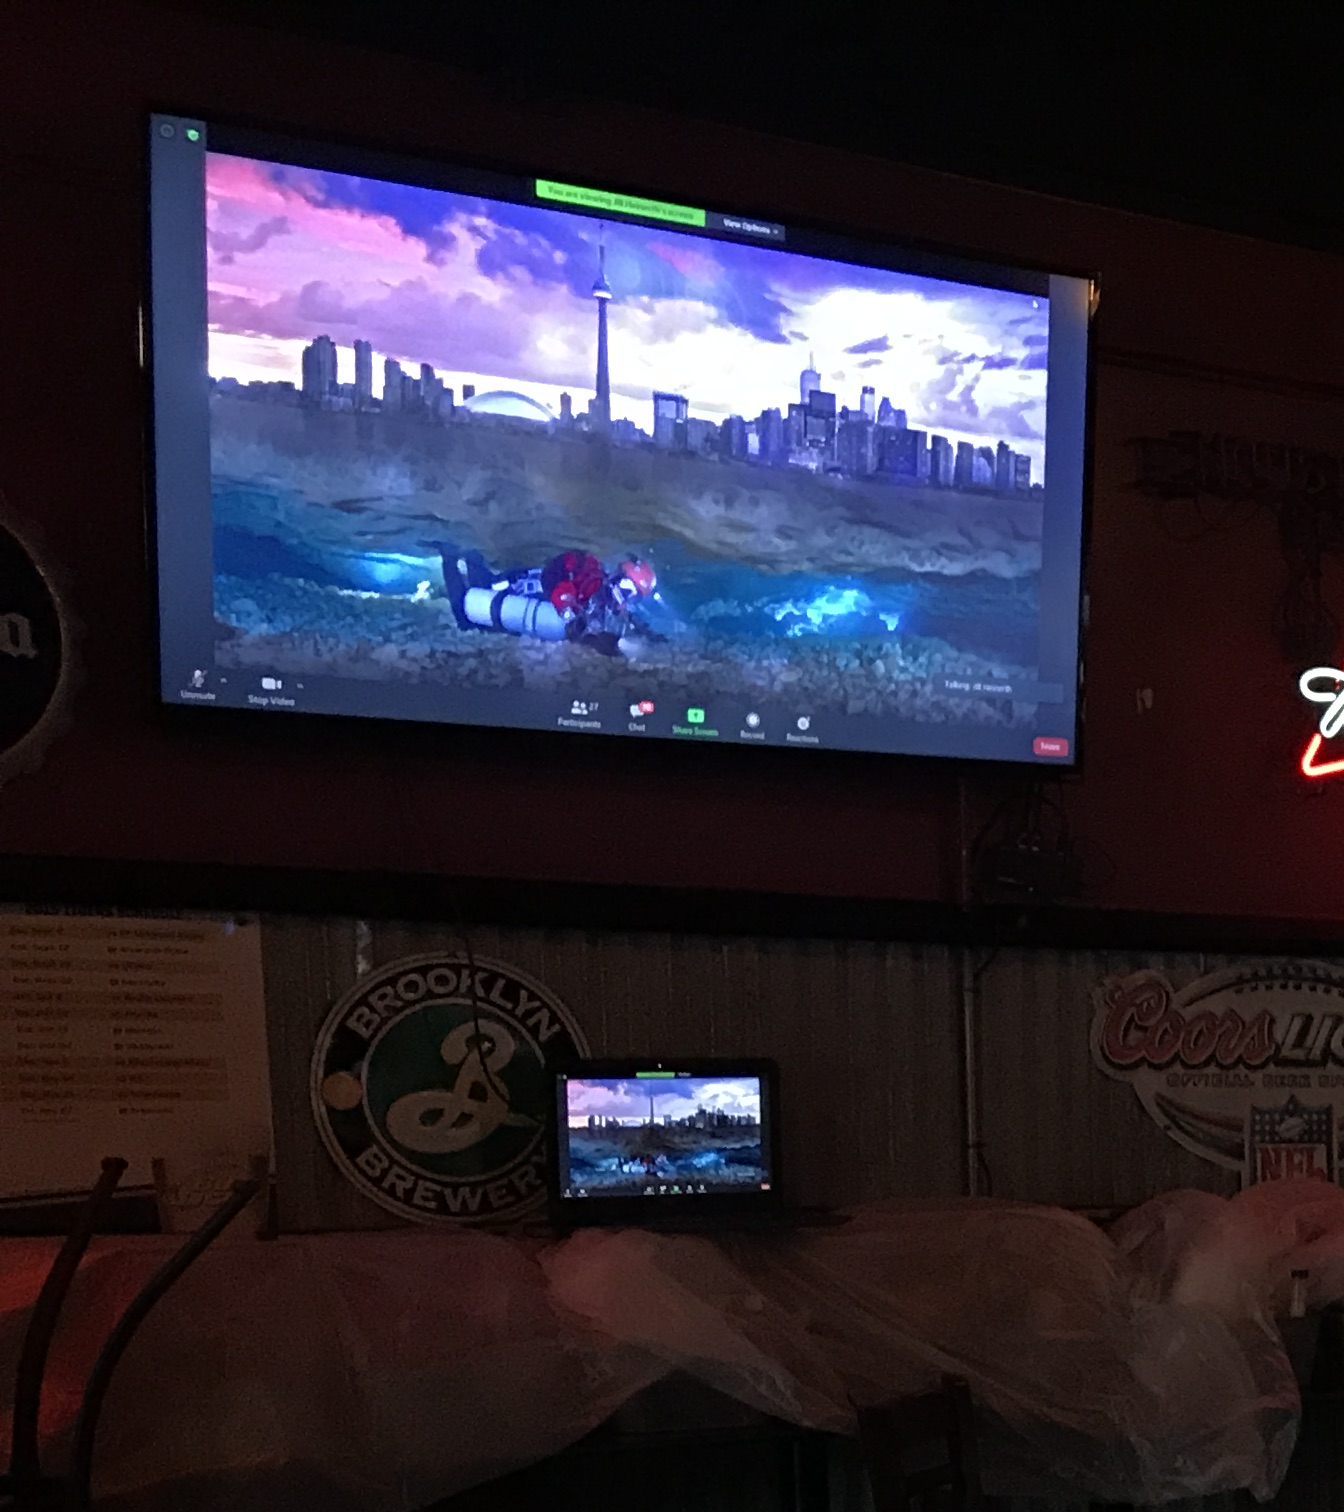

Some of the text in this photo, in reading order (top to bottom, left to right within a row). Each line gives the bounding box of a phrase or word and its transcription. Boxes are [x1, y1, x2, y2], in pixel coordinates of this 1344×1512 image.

[557, 716, 601, 729] Participants
[347, 966, 563, 1044] BROOKLYN
[1102, 979, 1278, 1071] Coors
[354, 1143, 548, 1214] BREWER
[1256, 1145, 1328, 1182] NFL
